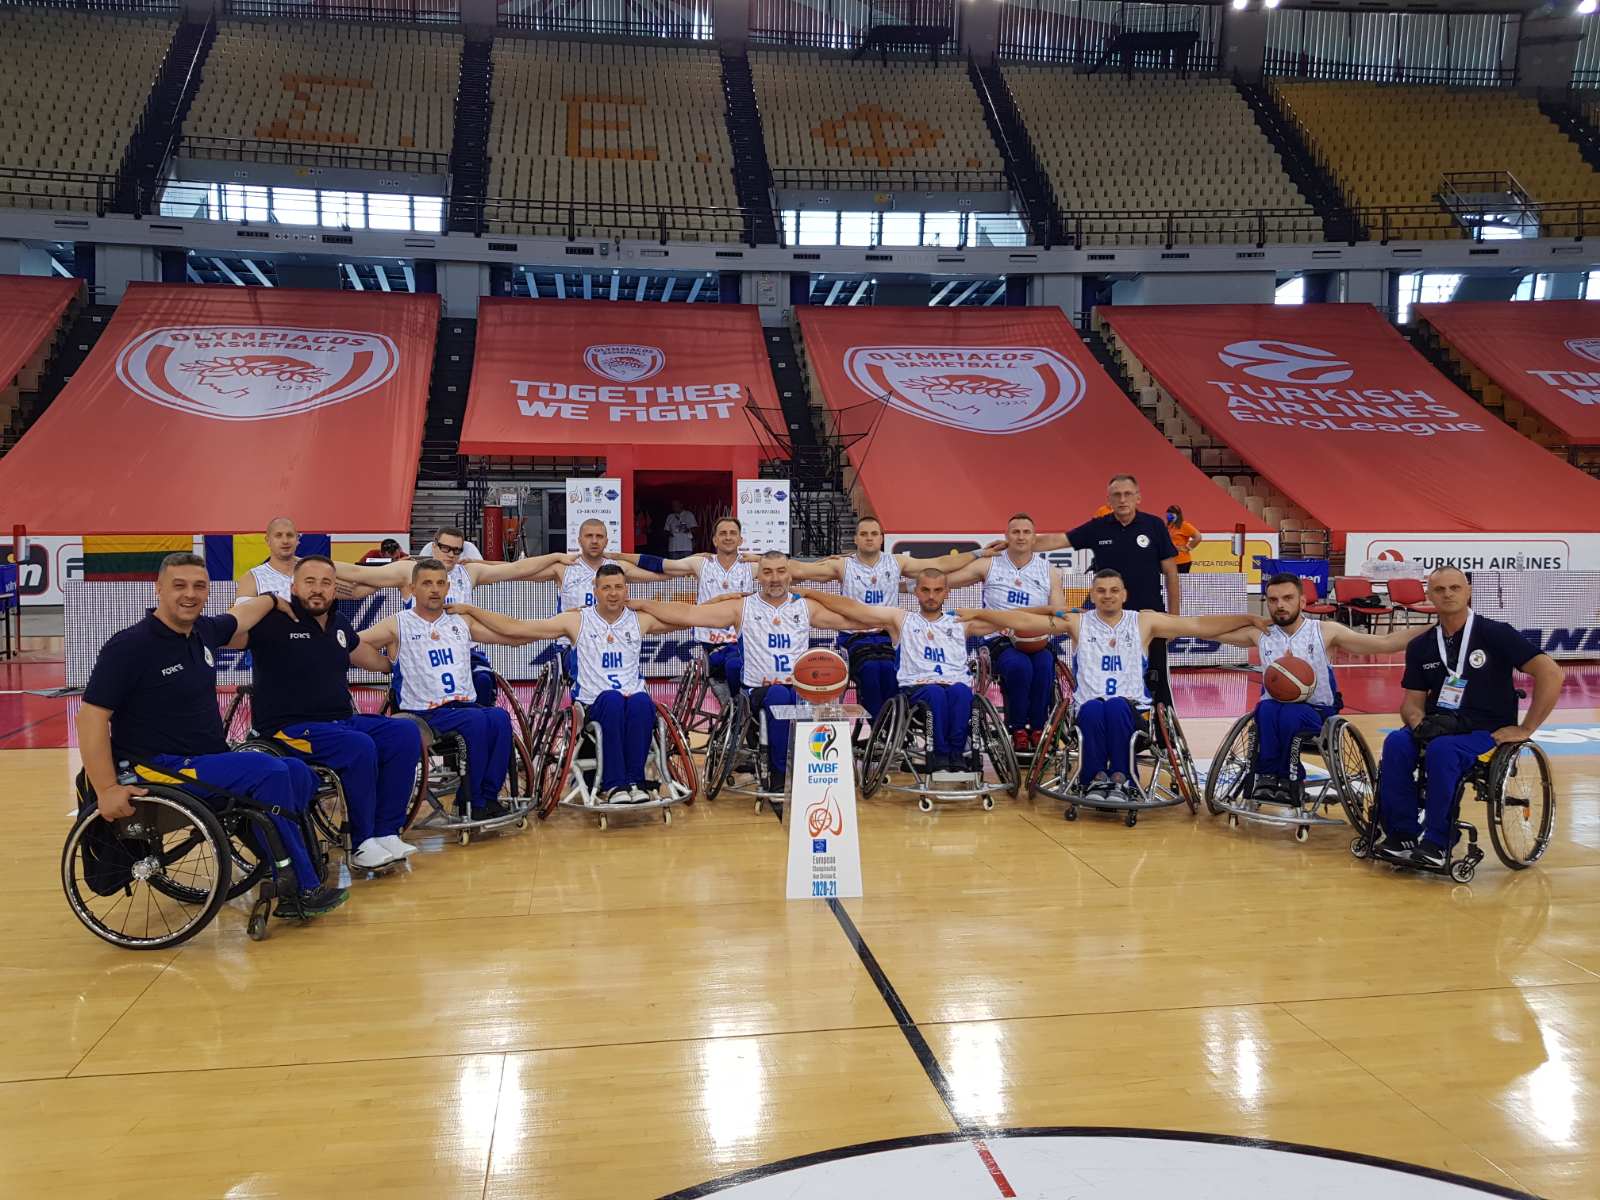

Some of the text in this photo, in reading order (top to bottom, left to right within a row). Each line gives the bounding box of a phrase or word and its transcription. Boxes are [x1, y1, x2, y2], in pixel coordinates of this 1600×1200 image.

[169, 332, 367, 346] OLYMPIACOS
[197, 341, 338, 352] BASKETBALL
[868, 352, 1036, 362] OLYMPIACOS
[895, 361, 1018, 369] BASKETBALL
[510, 380, 743, 403] TOGETHER
[1207, 381, 1437, 404] TURKISH
[517, 400, 735, 422] WE FIGHT
[1228, 396, 1460, 418] AIRLINES
[1413, 557, 1483, 570] TURKISH
[864, 590, 884, 604] BIH
[1007, 590, 1030, 606] BIH
[768, 633, 791, 649] BIH
[428, 648, 454, 667] BIH
[602, 652, 623, 669] BIH
[923, 646, 946, 663] BIH
[774, 654, 792, 673] 12
[933, 664, 943, 676] 4
[1101, 655, 1123, 672] BIH
[441, 672, 456, 694] 9
[607, 674, 622, 690] 5
[1105, 677, 1117, 696] 8
[808, 763, 839, 773] IWBF
[808, 776, 839, 785] Europe
[812, 880, 837, 897] 2020-21
